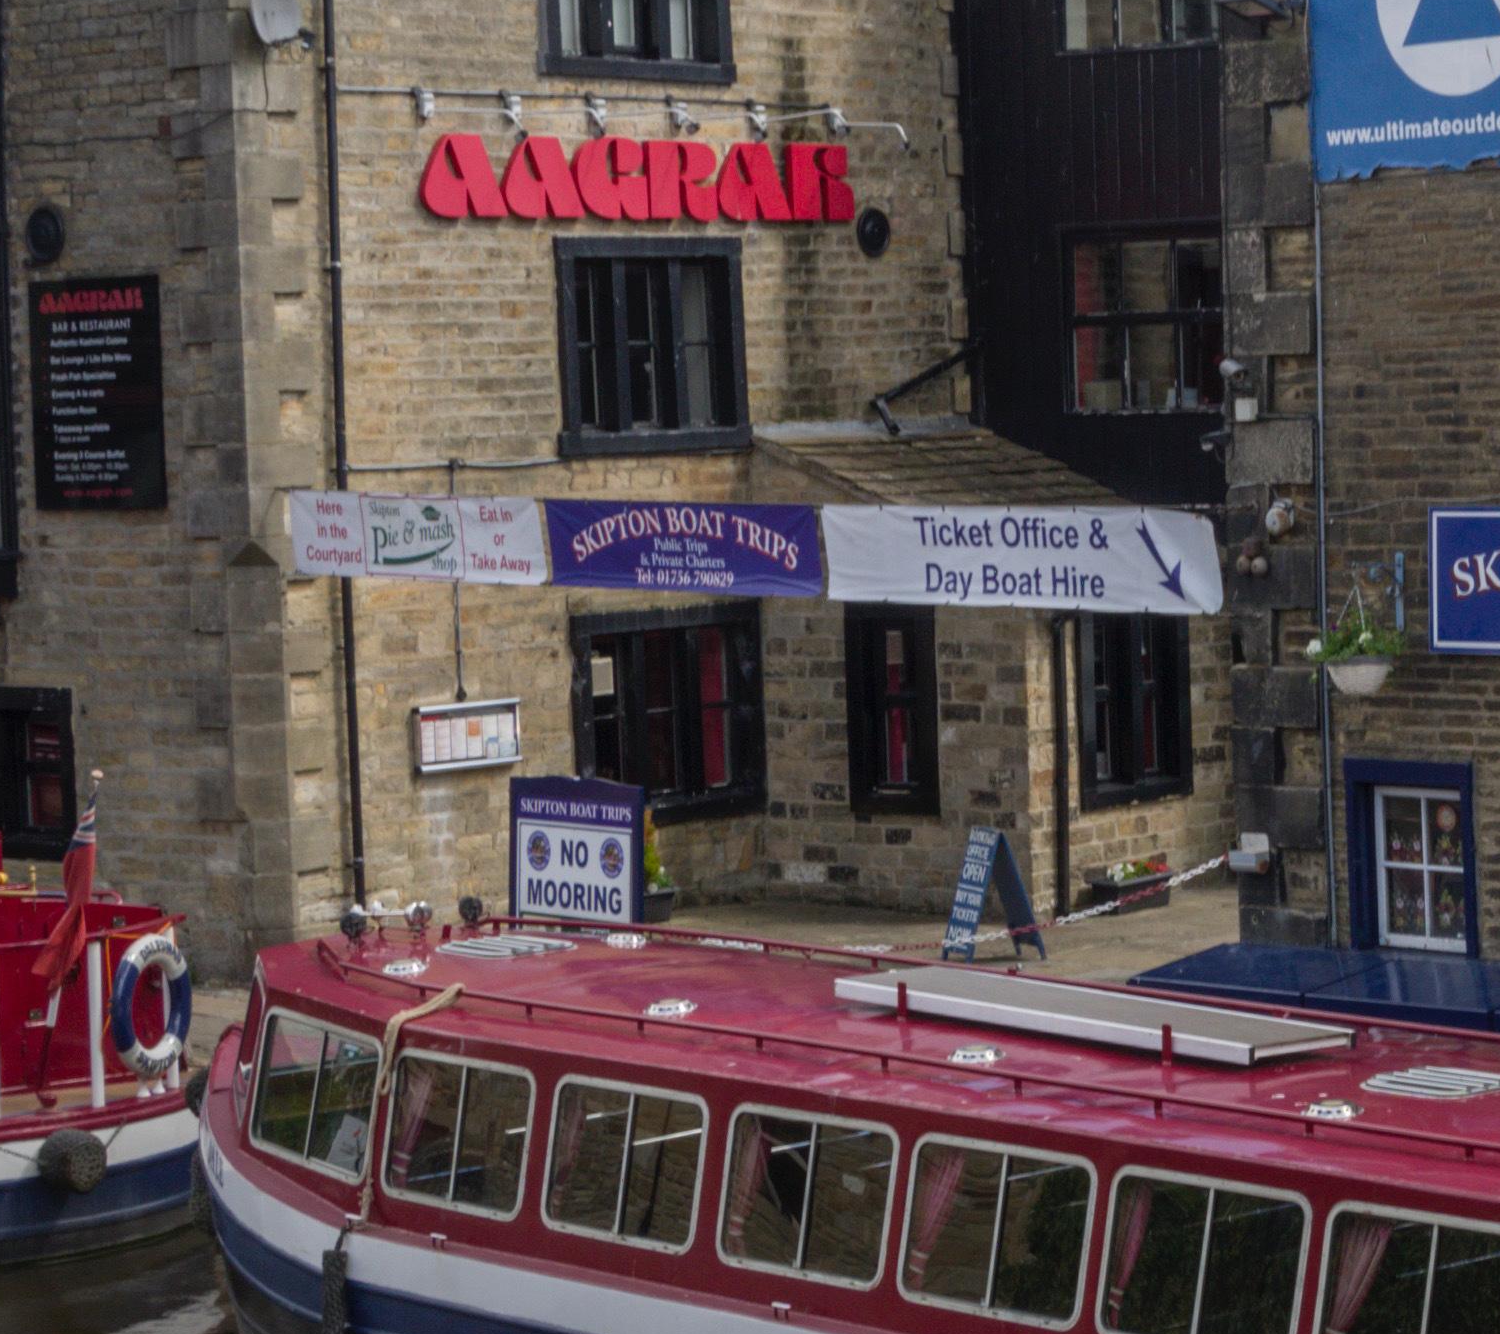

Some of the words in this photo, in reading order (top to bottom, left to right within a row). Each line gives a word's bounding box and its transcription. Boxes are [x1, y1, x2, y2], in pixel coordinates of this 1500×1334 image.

[420, 133, 856, 221] AAGRAH
[52, 321, 68, 333] BAR
[80, 317, 131, 332] RESTAURANT
[316, 499, 343, 516] Here
[479, 505, 499, 522] Eat
[501, 507, 513, 523] In
[317, 522, 328, 538] in
[330, 523, 348, 539] the
[419, 515, 456, 543] mash
[493, 533, 505, 546] or
[572, 507, 663, 563] SKIPTON
[664, 507, 725, 539] BOAT
[731, 515, 799, 570] TRIPS
[913, 516, 994, 547] Ticket
[1000, 516, 1079, 549] Office
[1089, 518, 1109, 550] &
[306, 545, 363, 566] Courtyard
[654, 537, 683, 552] Public
[684, 538, 708, 554] Trips
[431, 553, 457, 573] shop
[471, 553, 497, 571] Take
[500, 554, 532, 575] Away
[652, 552, 684, 567] Private
[685, 553, 726, 568] Charters
[656, 570, 691, 586] 01756
[693, 570, 734, 588] 790829
[925, 562, 973, 601] Day
[982, 564, 1043, 597] Boat
[1051, 566, 1106, 598] Hire
[520, 797, 568, 814] SKIPTON
[569, 802, 598, 819] BOAT
[600, 805, 632, 822] TRIPS
[561, 838, 589, 869] NO
[962, 862, 986, 883] OPEN
[527, 877, 622, 915] MOORING
